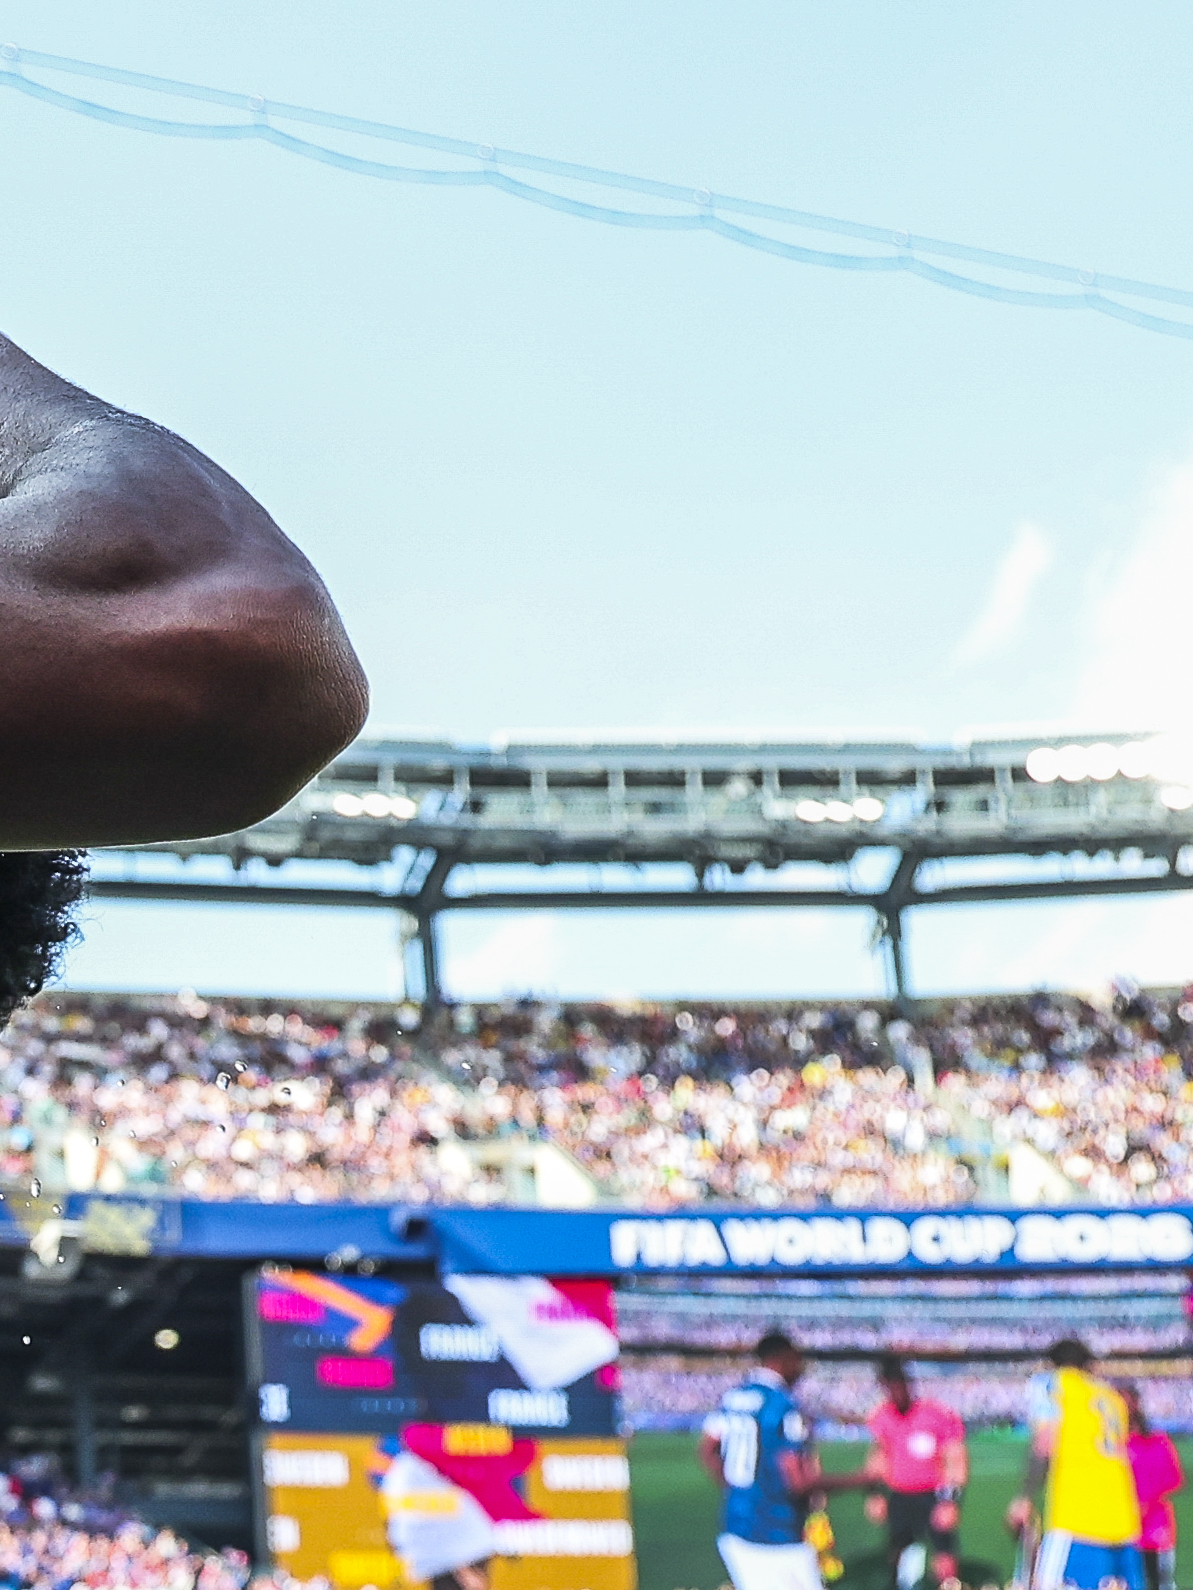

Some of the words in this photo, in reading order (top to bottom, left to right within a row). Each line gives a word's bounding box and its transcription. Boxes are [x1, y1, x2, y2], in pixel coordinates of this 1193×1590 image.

[610, 1218, 729, 1268] FIFA
[720, 1216, 909, 1267] WORLD
[908, 1214, 1017, 1265] CUP
[1013, 1211, 1193, 1264] 2026
